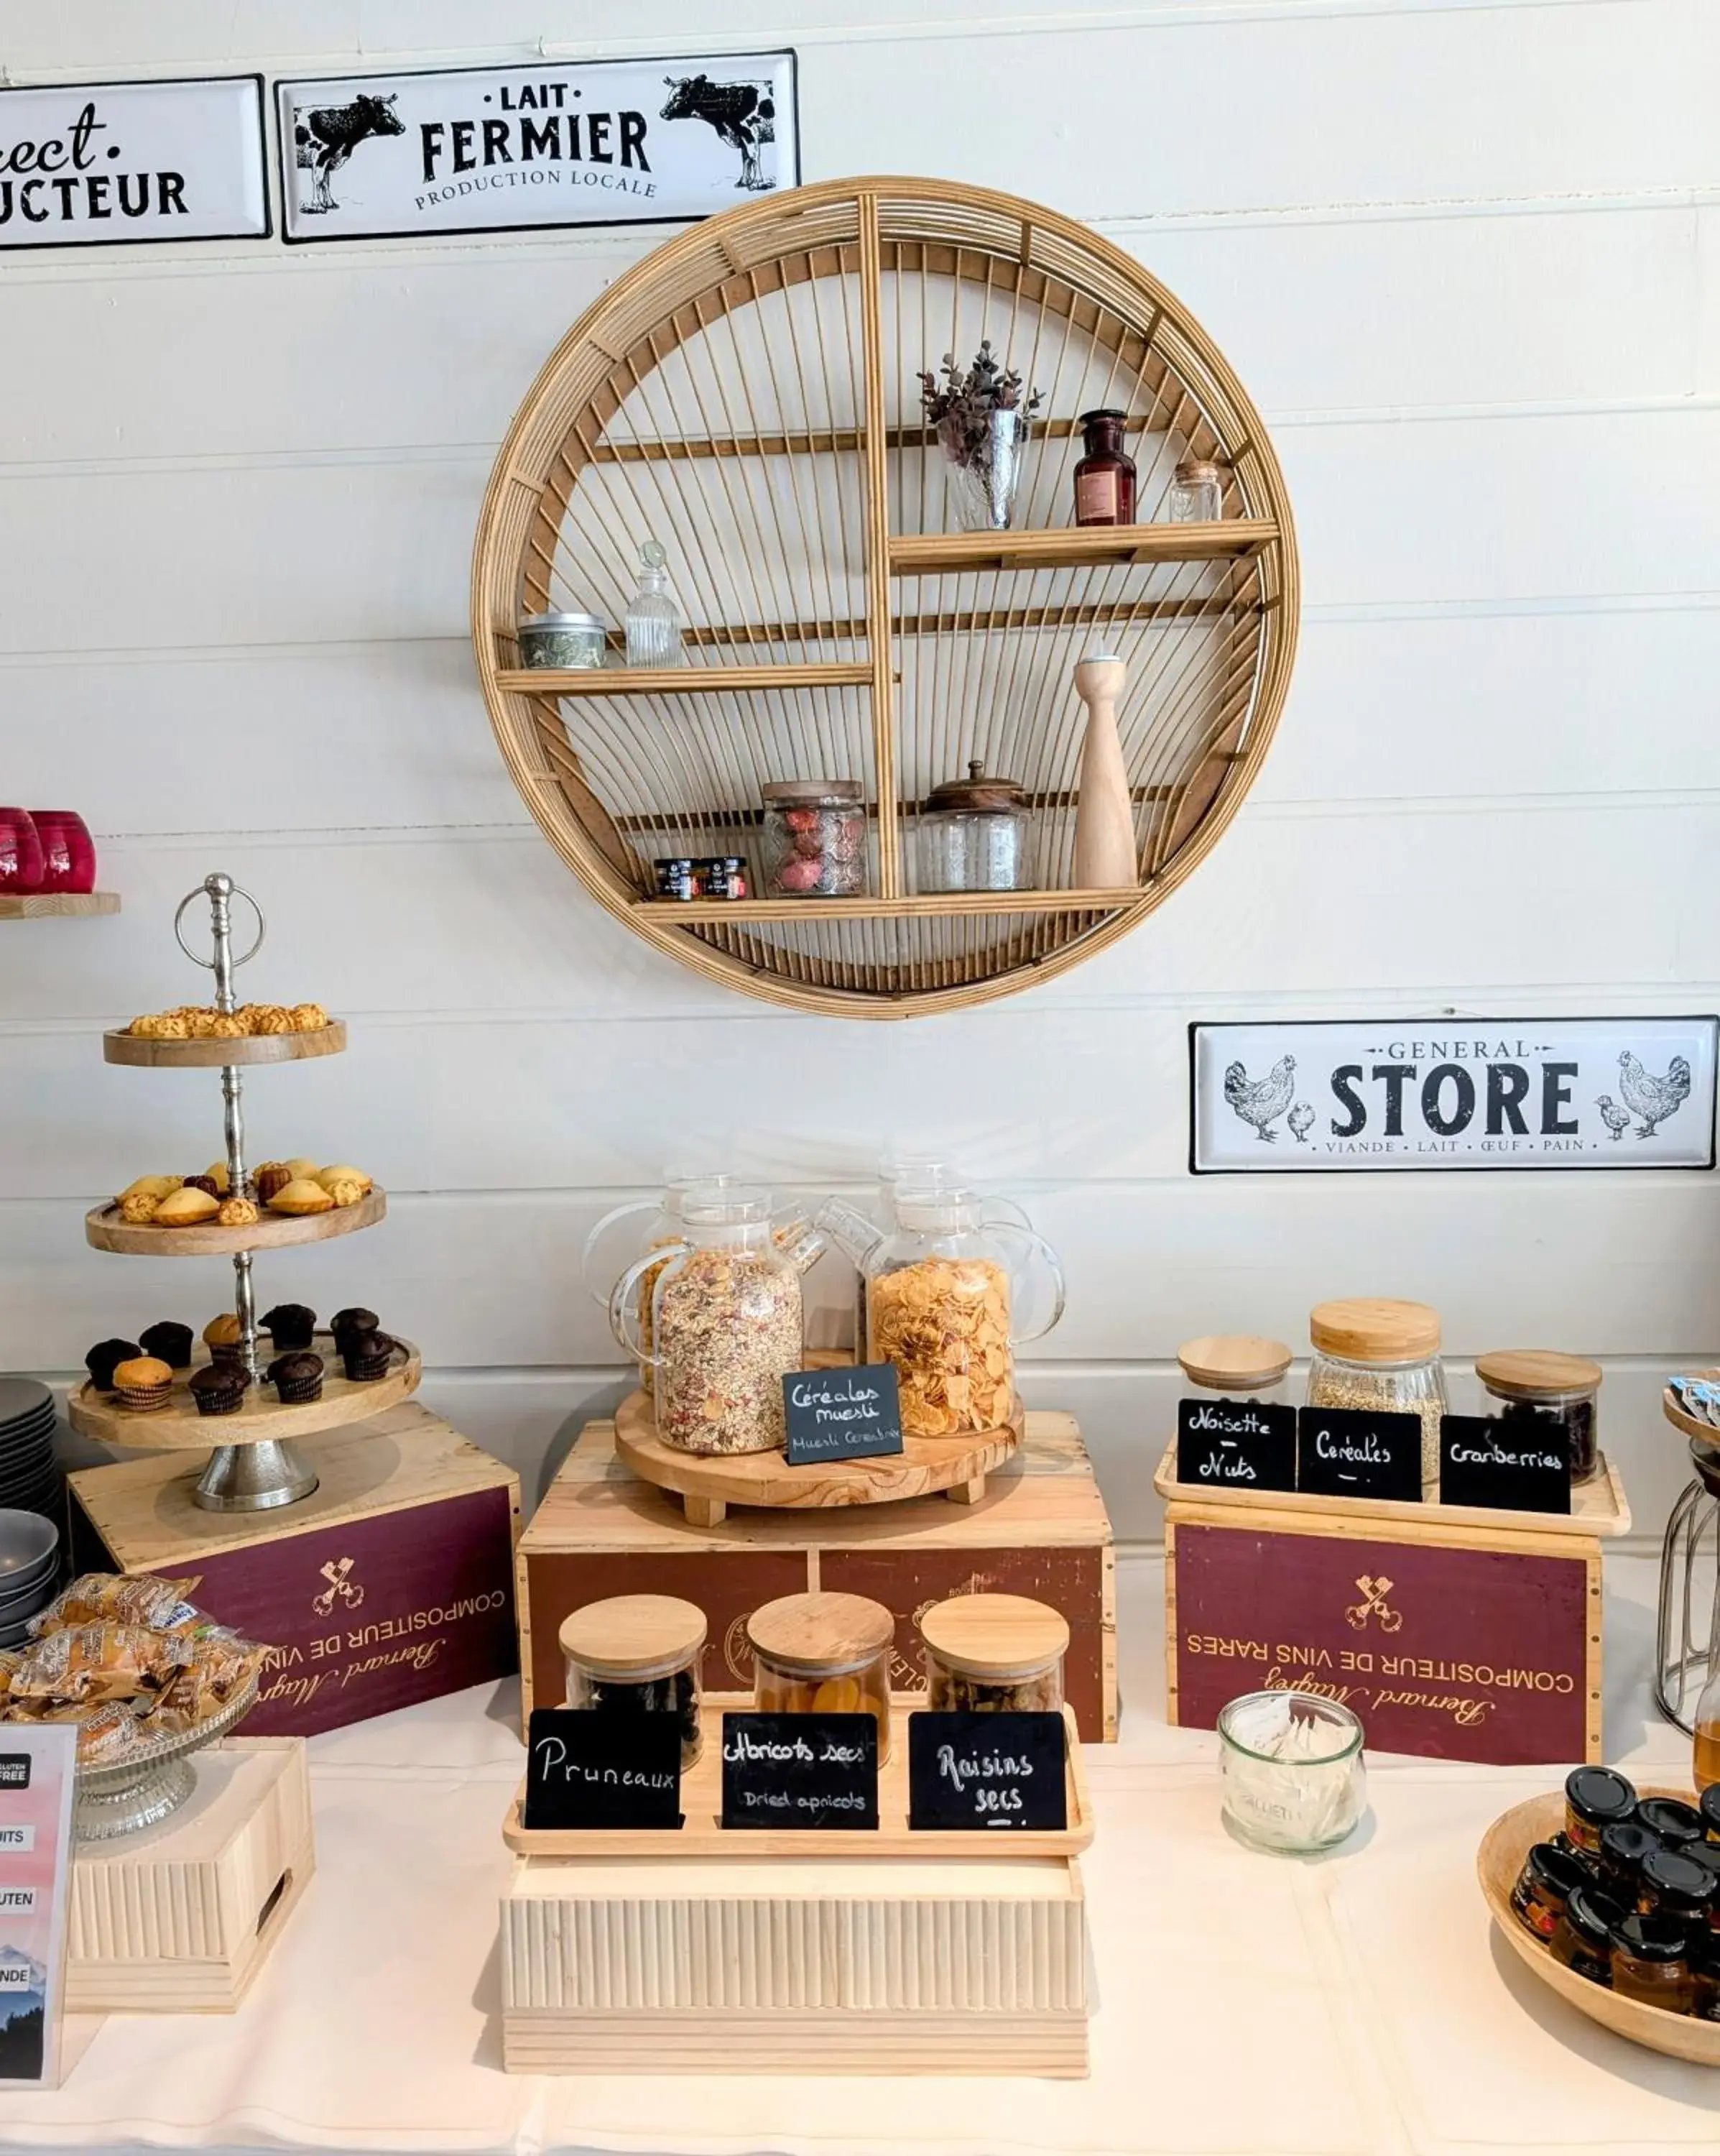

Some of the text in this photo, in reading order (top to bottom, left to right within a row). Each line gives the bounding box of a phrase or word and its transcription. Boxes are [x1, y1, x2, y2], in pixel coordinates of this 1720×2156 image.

[501, 83, 568, 111] LAIT
[0, 102, 106, 173] ect
[420, 110, 652, 185] FERMIER
[415, 170, 657, 211] PRODUCTION LOCALE
[1387, 1040, 1530, 1060] GENERAL
[1330, 1062, 1578, 1137] STORE
[1326, 1139, 1584, 1153] VIANDE LAIT ŒUF PAIN
[792, 1378, 880, 1408] Céréales
[816, 1402, 881, 1425] muesli
[1188, 1406, 1271, 1434] Noisette
[1199, 1451, 1257, 1480] Nuts
[1450, 1442, 1563, 1470] Cranberries
[347, 1590, 505, 1649] COMPOSITEUR
[310, 1634, 341, 1660] DE
[341, 1637, 446, 1688] Bernard
[1187, 1634, 1574, 1693] COMPOSITEUR DE VINS RARES
[1371, 1689, 1496, 1726] Bernard
[723, 1731, 815, 1761] Abricots
[535, 1736, 675, 1789] Pruneaux
[937, 1744, 1034, 1792] Raisins
[744, 1791, 790, 1808] Dried
[975, 1787, 1023, 1812] secs
